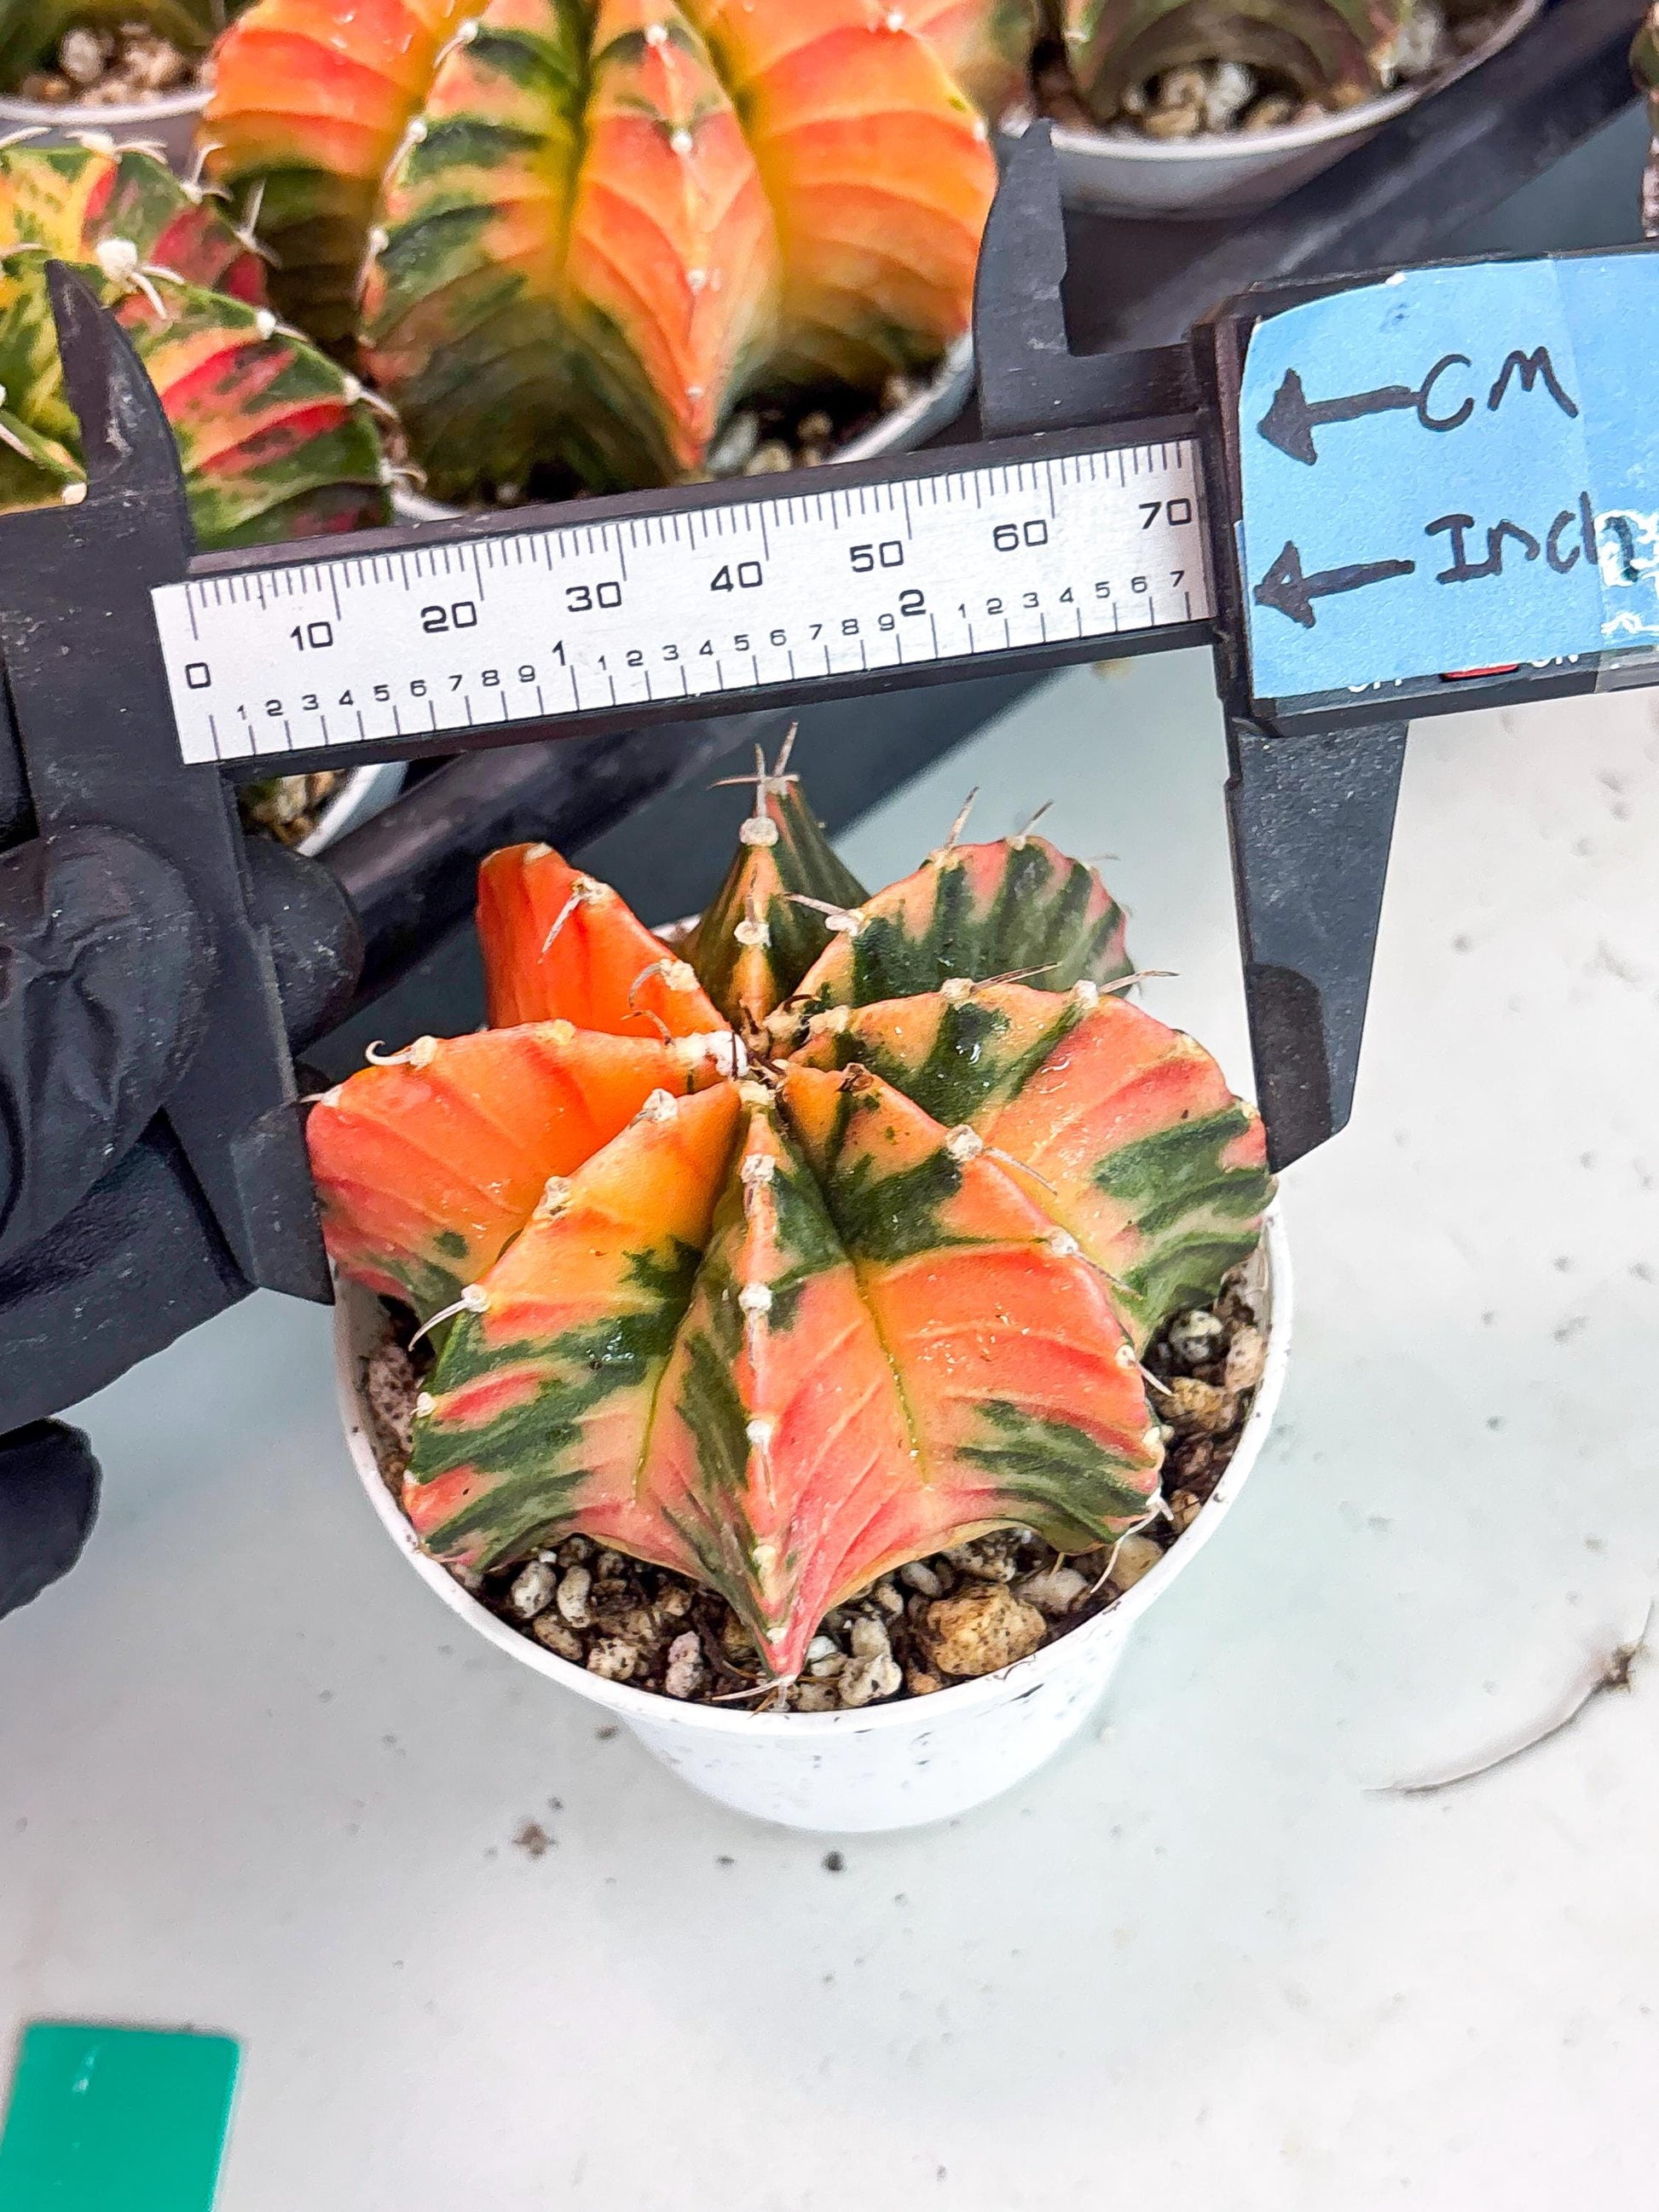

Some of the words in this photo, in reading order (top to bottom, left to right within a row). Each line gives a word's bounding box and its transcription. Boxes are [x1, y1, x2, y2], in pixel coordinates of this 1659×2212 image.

[1416, 346, 1579, 433] CM
[184, 661, 212, 690] 0
[289, 621, 334, 652] 10
[419, 600, 478, 634] 20
[564, 580, 623, 613] 30
[709, 560, 764, 592] 40
[849, 540, 905, 574] 50
[992, 518, 1049, 552] 60
[1138, 498, 1192, 530] 70
[1425, 490, 1640, 585] Inch
[236, 704, 247, 721] 1
[264, 698, 285, 718] 2
[301, 693, 320, 712] 3
[338, 689, 355, 707] 4
[373, 684, 390, 702] 5
[409, 679, 428, 698] 6
[448, 673, 464, 692] 7
[480, 668, 501, 688] 8
[517, 664, 536, 684] 9
[551, 639, 566, 667] 1
[597, 655, 607, 672] 1
[625, 649, 645, 668] 2
[662, 644, 680, 661] 3
[698, 638, 714, 656] 4
[733, 633, 750, 652] 5
[769, 628, 788, 647] 6
[808, 622, 824, 641] 7
[841, 617, 860, 637] 8
[877, 613, 896, 632] 9
[898, 588, 927, 618] 2
[957, 603, 967, 619] 1
[986, 597, 1004, 616] 2
[1022, 591, 1040, 609] 3
[1058, 586, 1075, 604] 4
[1094, 580, 1111, 599] 5
[1130, 575, 1148, 594] 6
[1169, 569, 1186, 588] 7
